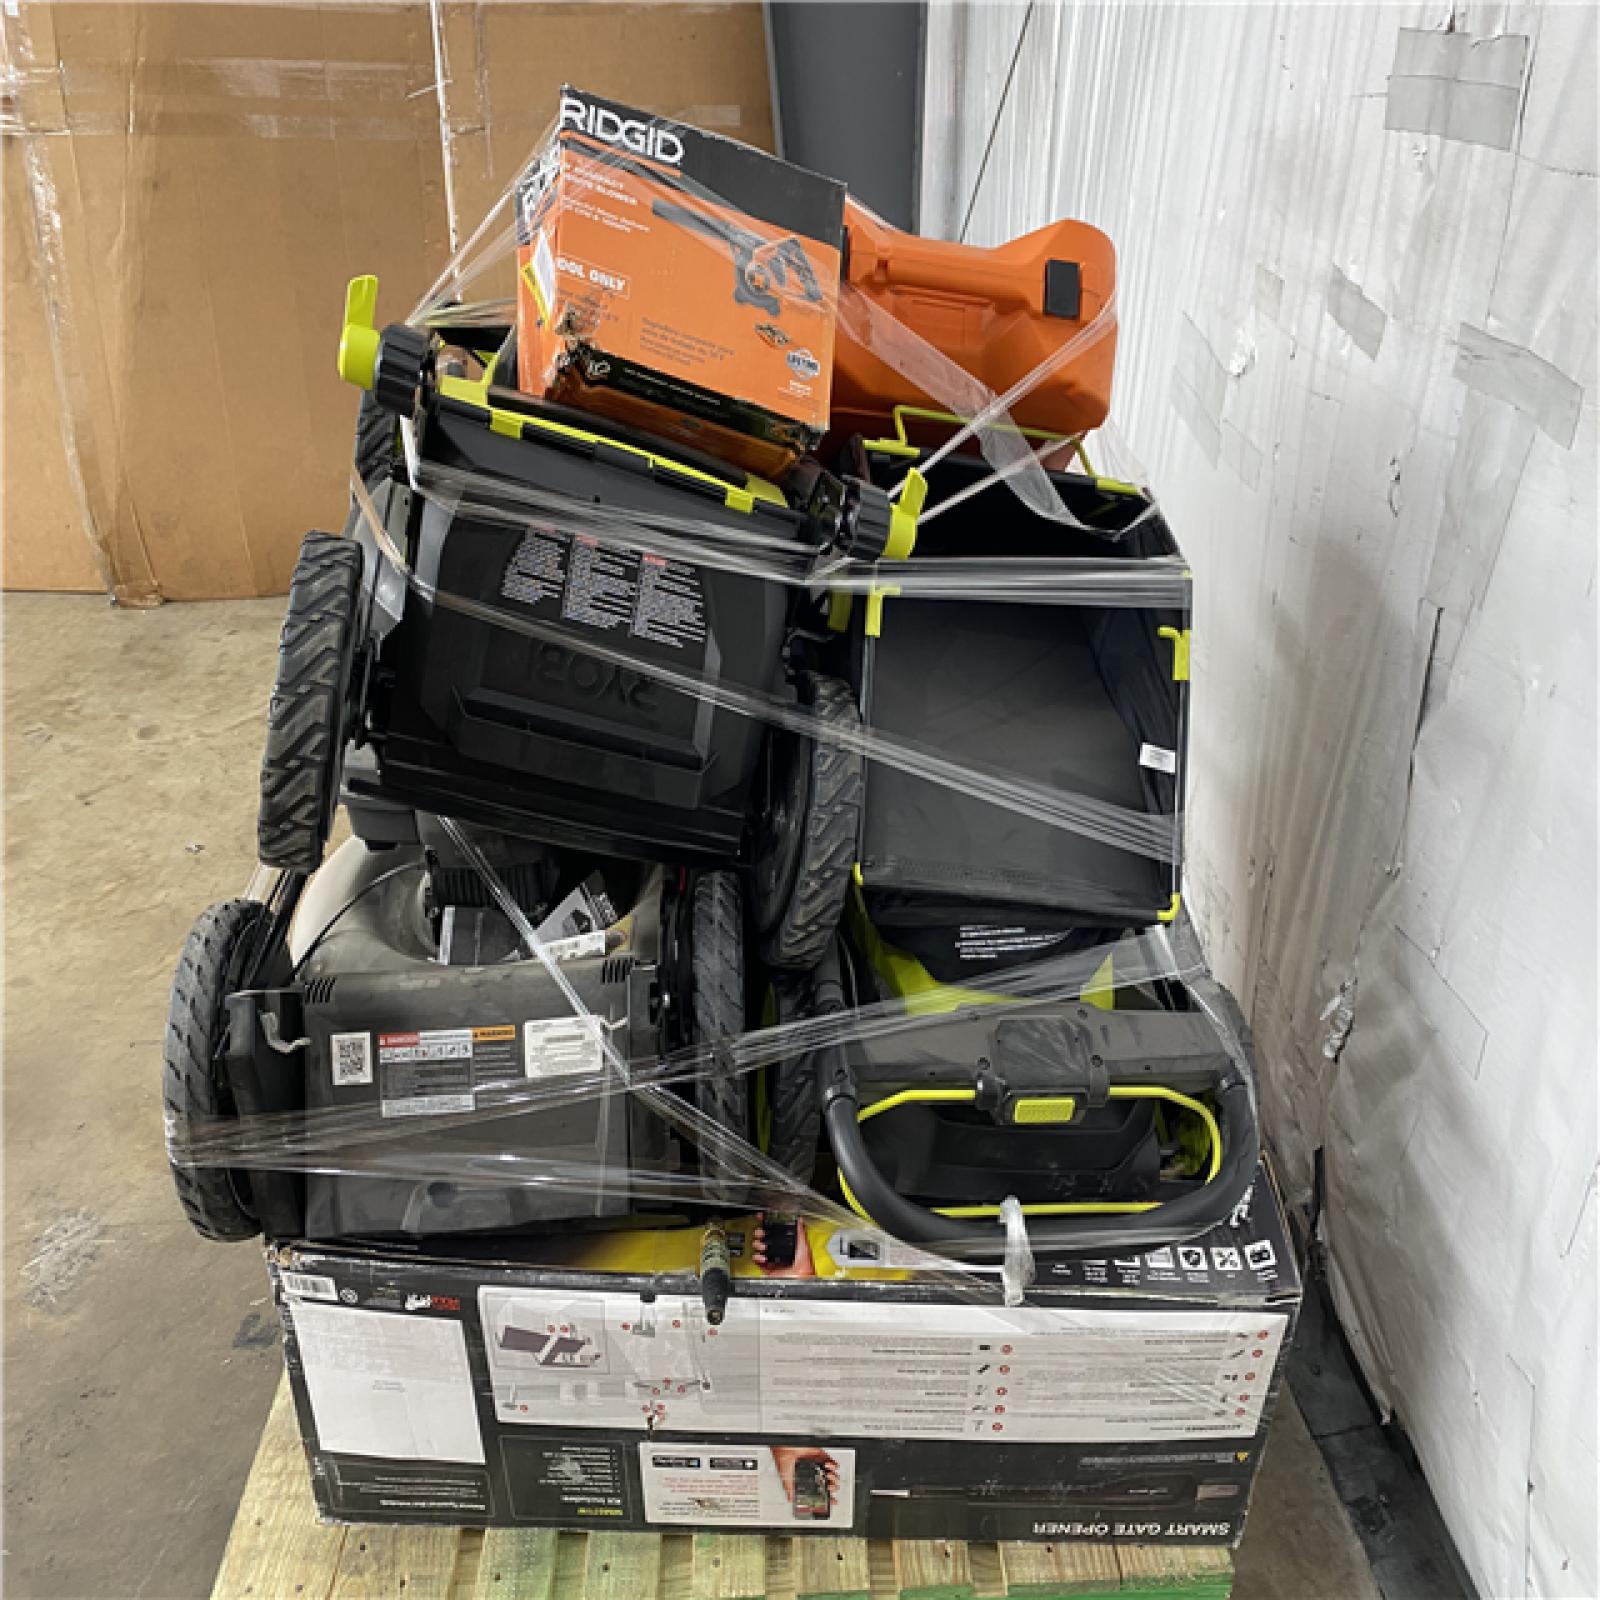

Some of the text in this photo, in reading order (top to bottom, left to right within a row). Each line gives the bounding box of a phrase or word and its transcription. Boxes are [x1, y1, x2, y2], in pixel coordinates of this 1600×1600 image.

[560, 96, 685, 163] RIDGID
[557, 258, 585, 279] OOL
[1032, 1522, 1231, 1536] SMART GATE OPENER
